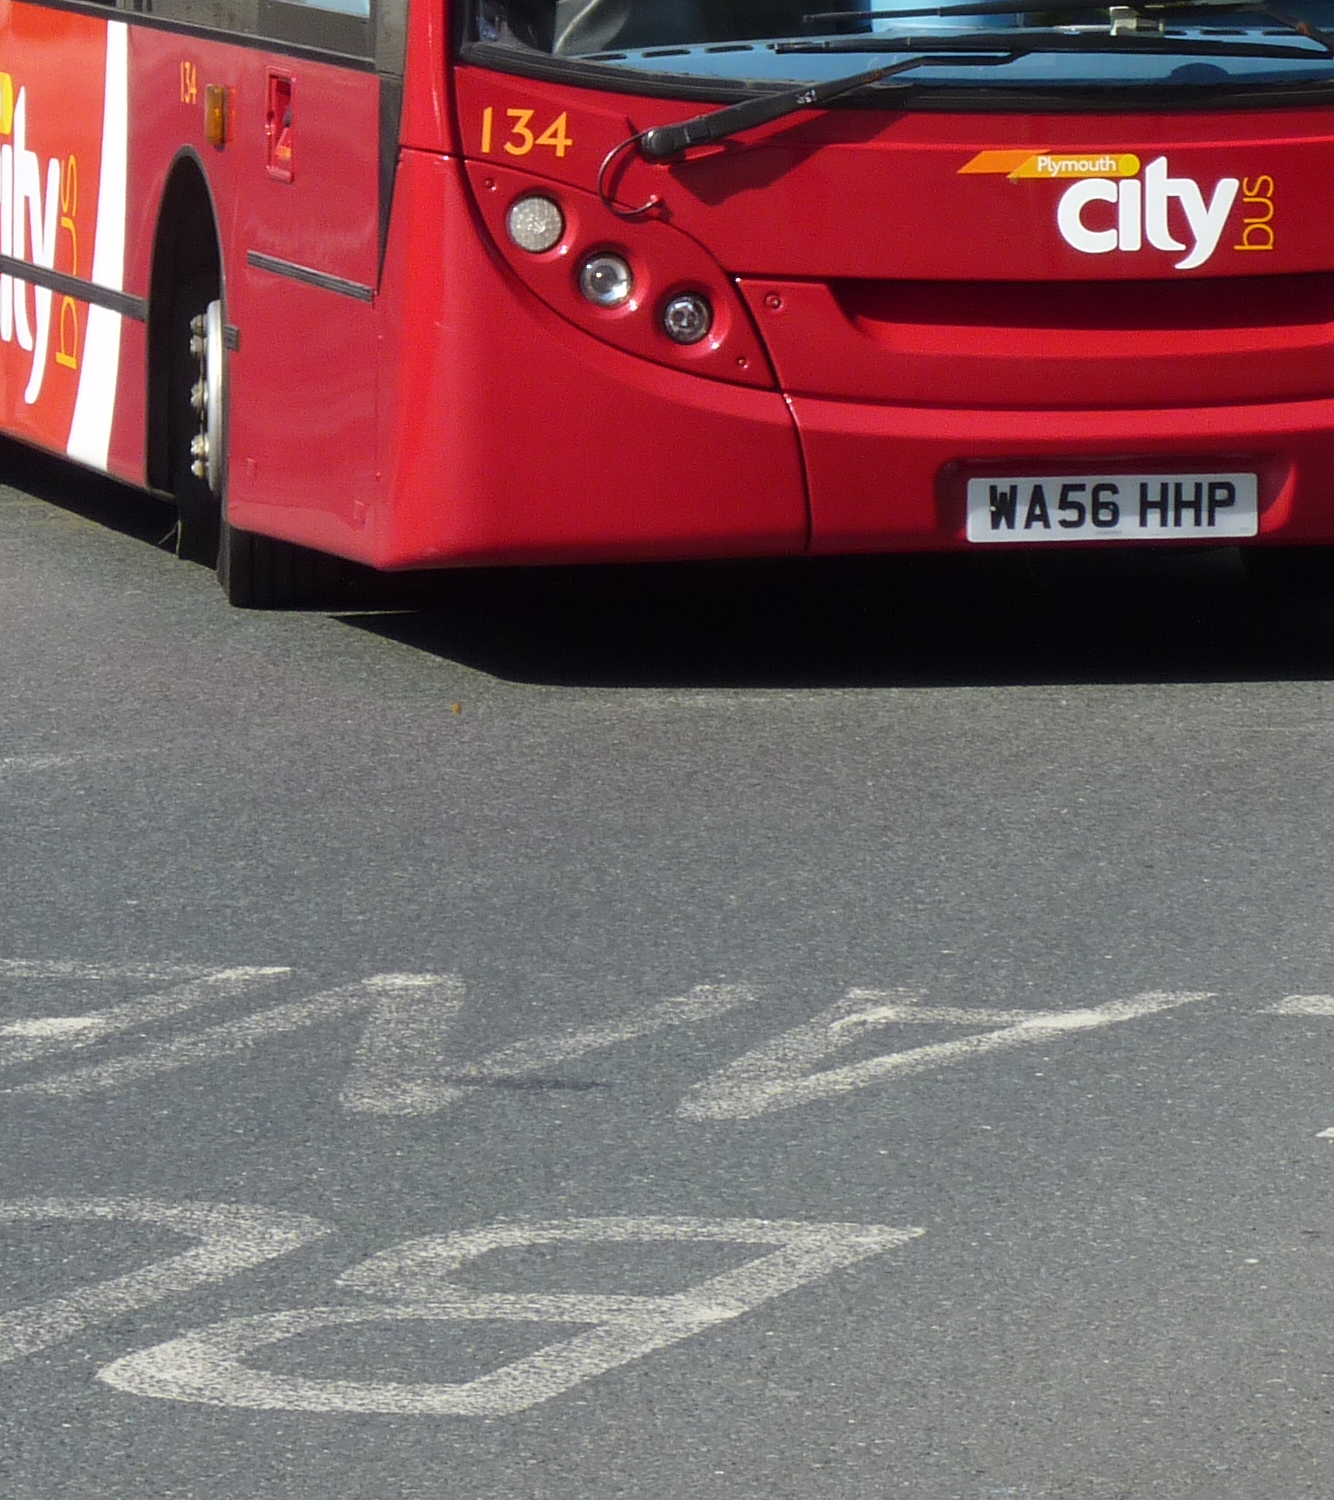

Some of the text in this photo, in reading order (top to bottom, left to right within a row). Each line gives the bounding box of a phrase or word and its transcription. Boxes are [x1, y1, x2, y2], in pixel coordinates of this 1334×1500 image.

[180, 61, 198, 105] 134
[481, 106, 573, 158] 134
[1036, 155, 1117, 177] Plymouth
[1057, 156, 1240, 270] city
[1233, 174, 1275, 251] bus
[55, 155, 78, 370] bus
[988, 481, 1237, 530] WA56 HHP
